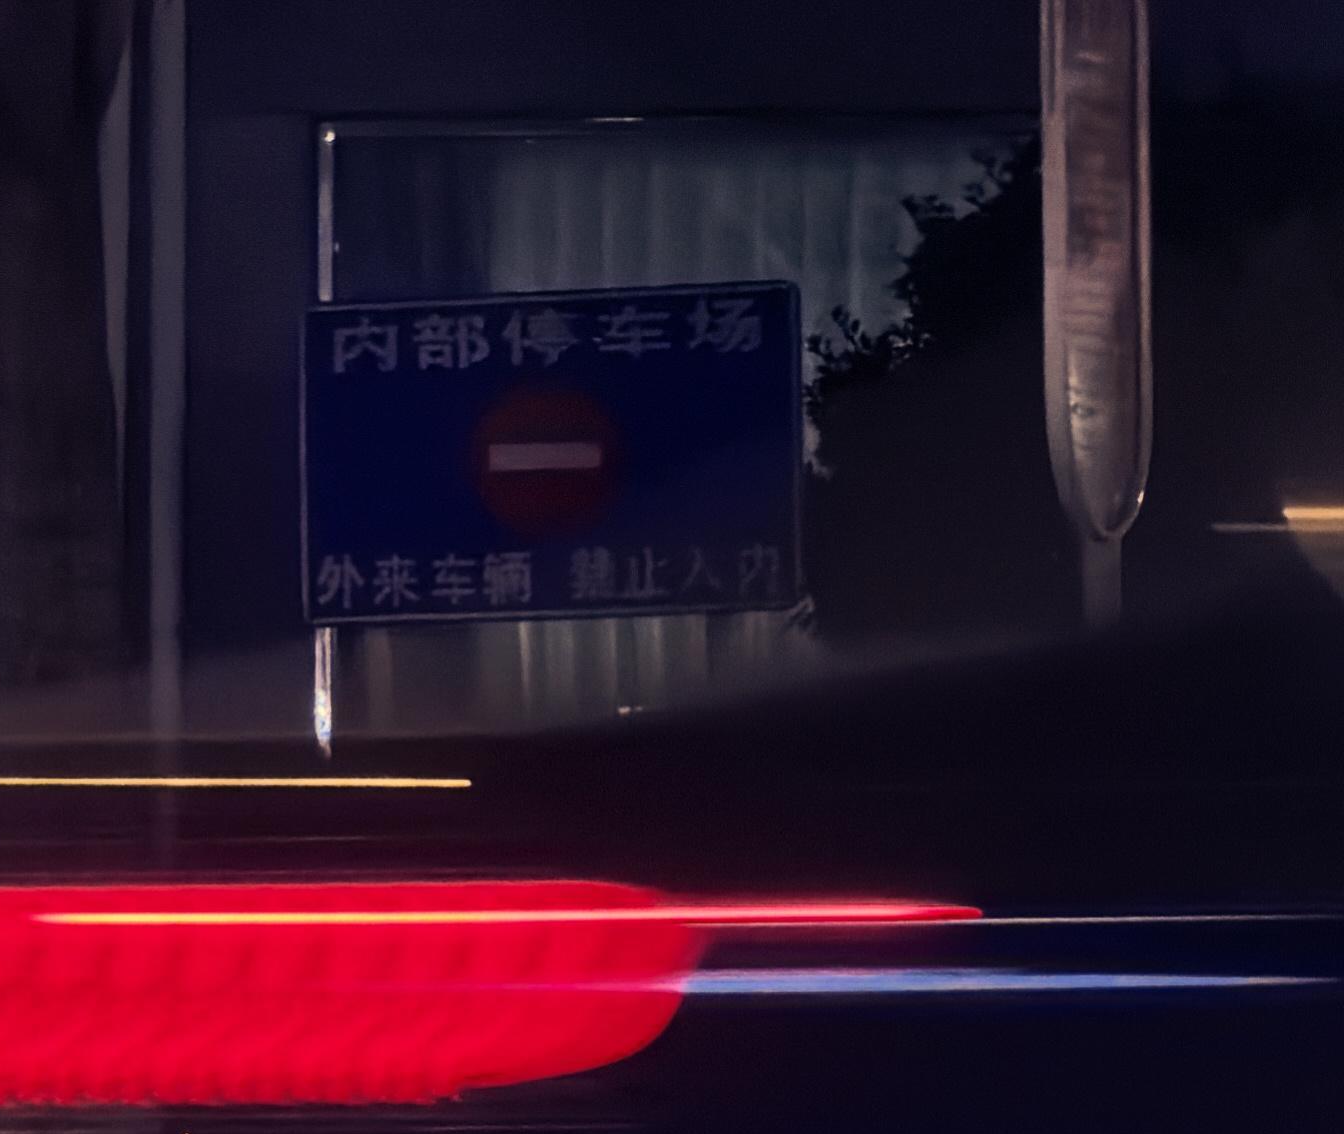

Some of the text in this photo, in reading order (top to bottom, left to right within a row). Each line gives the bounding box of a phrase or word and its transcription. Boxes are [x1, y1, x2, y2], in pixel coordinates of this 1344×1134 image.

[331, 297, 763, 374] 内部停车场
[317, 552, 532, 609] 外来车辆
